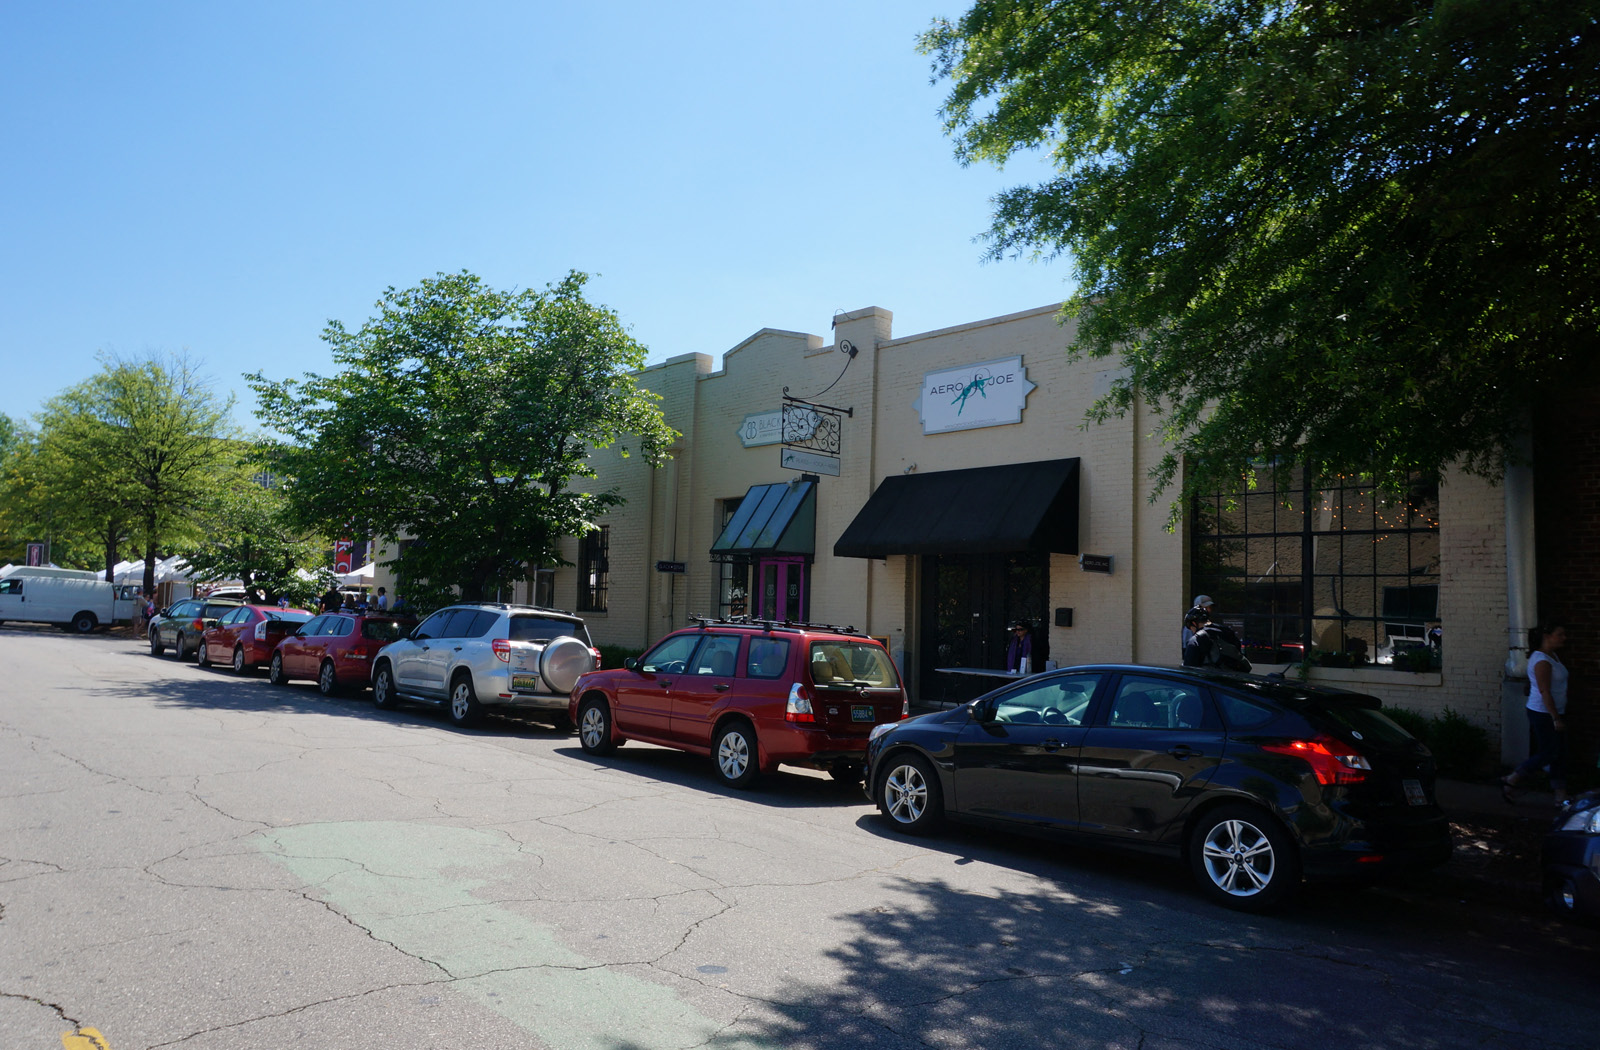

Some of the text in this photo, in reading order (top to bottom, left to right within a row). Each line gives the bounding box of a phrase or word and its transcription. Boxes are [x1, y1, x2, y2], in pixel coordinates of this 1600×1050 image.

[930, 373, 1014, 396] AERO JOE
[759, 417, 781, 430] BLACK
